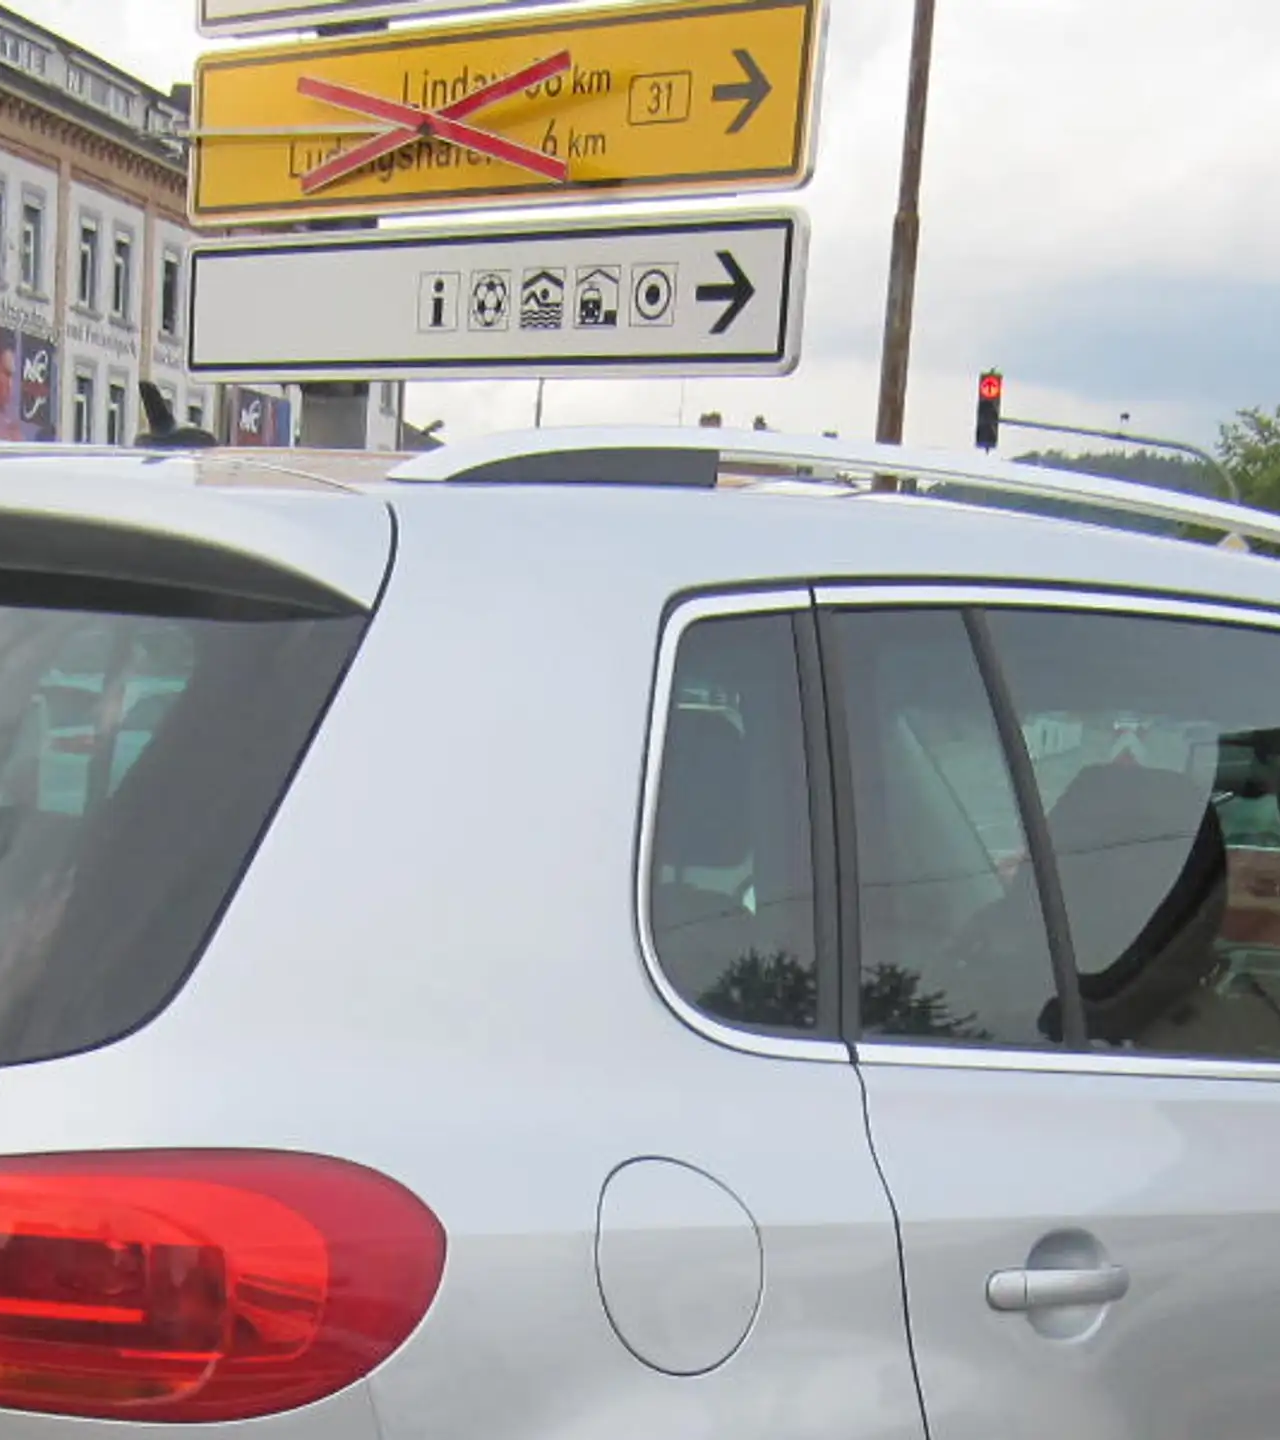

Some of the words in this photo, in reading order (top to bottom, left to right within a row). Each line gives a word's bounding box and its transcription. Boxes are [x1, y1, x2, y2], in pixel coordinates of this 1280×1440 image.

[402, 64, 509, 108] Linda
[573, 64, 610, 95] km
[647, 81, 672, 115] 31
[542, 119, 558, 157] 6
[568, 127, 605, 157] km
